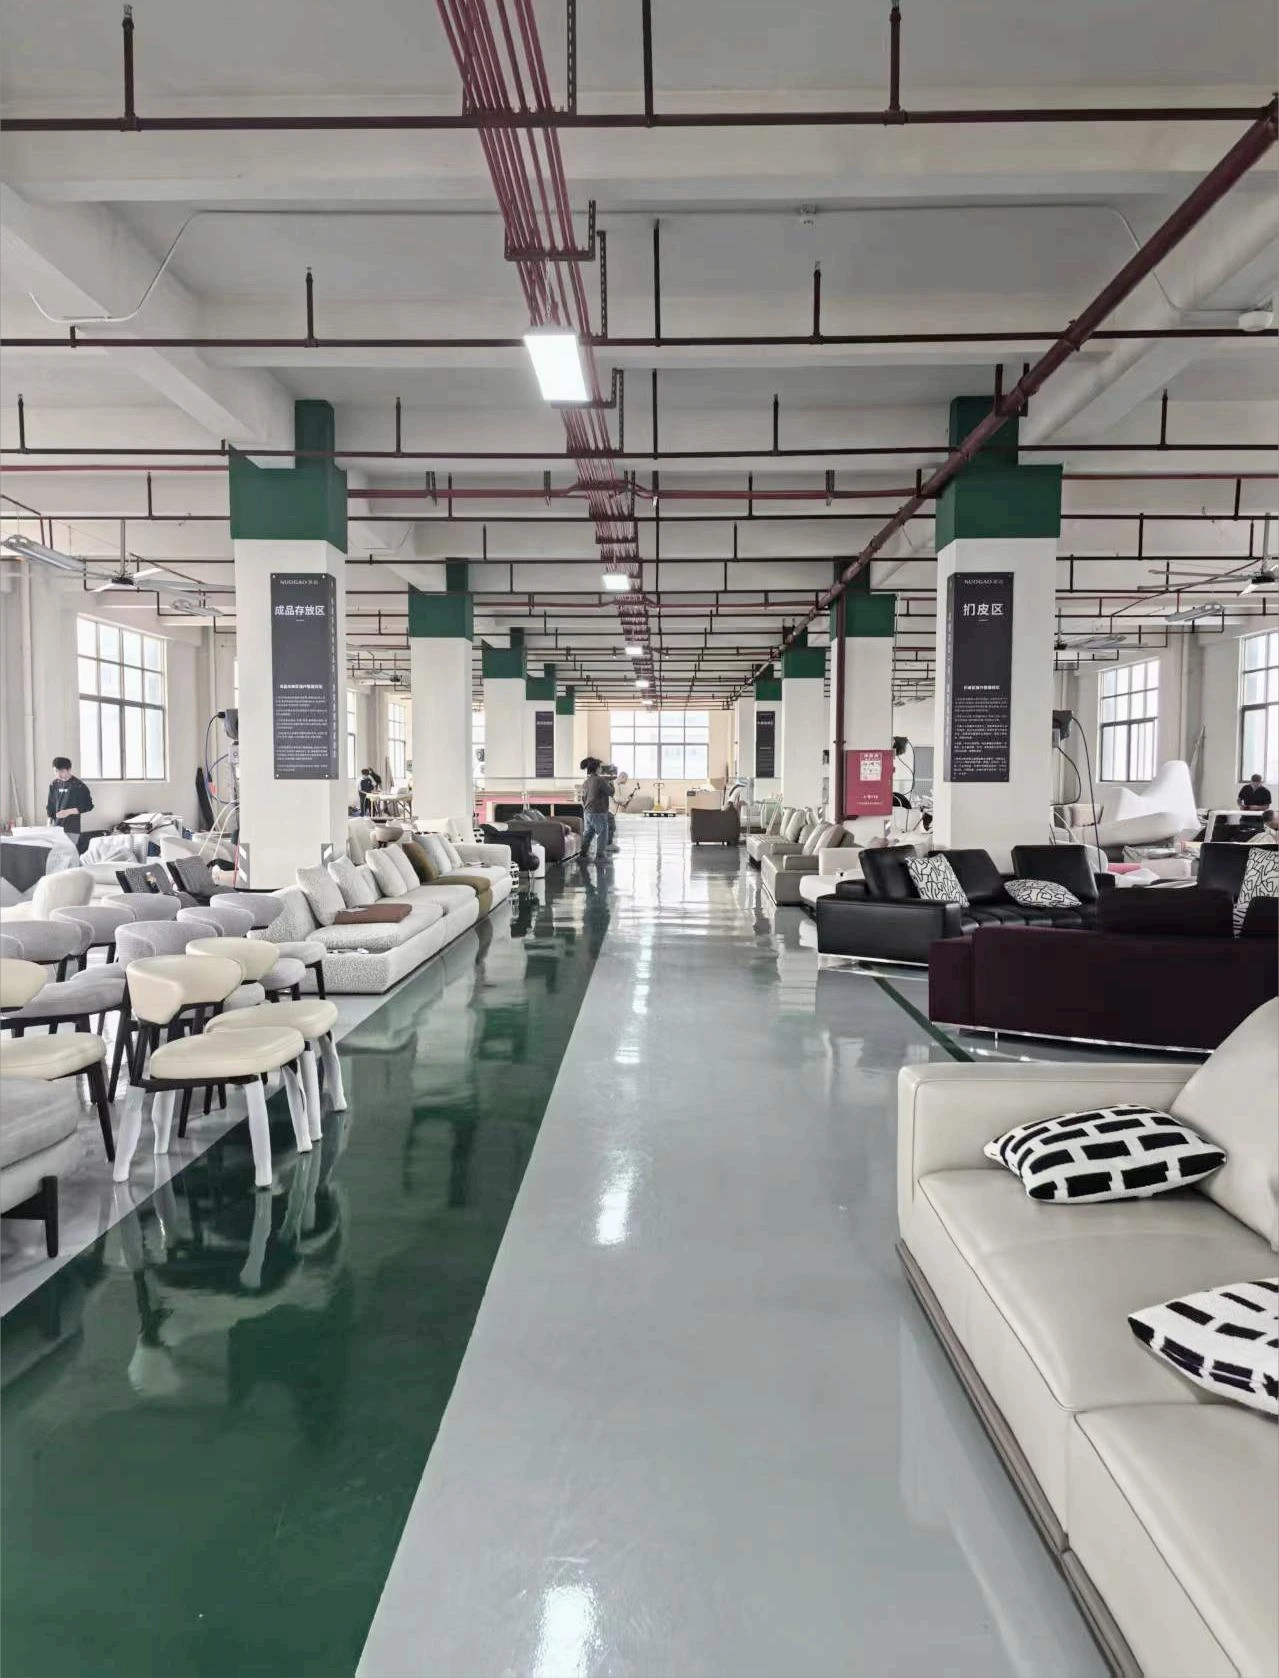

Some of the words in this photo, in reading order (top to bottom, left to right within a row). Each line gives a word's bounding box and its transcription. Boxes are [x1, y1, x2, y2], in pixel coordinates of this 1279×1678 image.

[275, 604, 326, 616] 成品存放区
